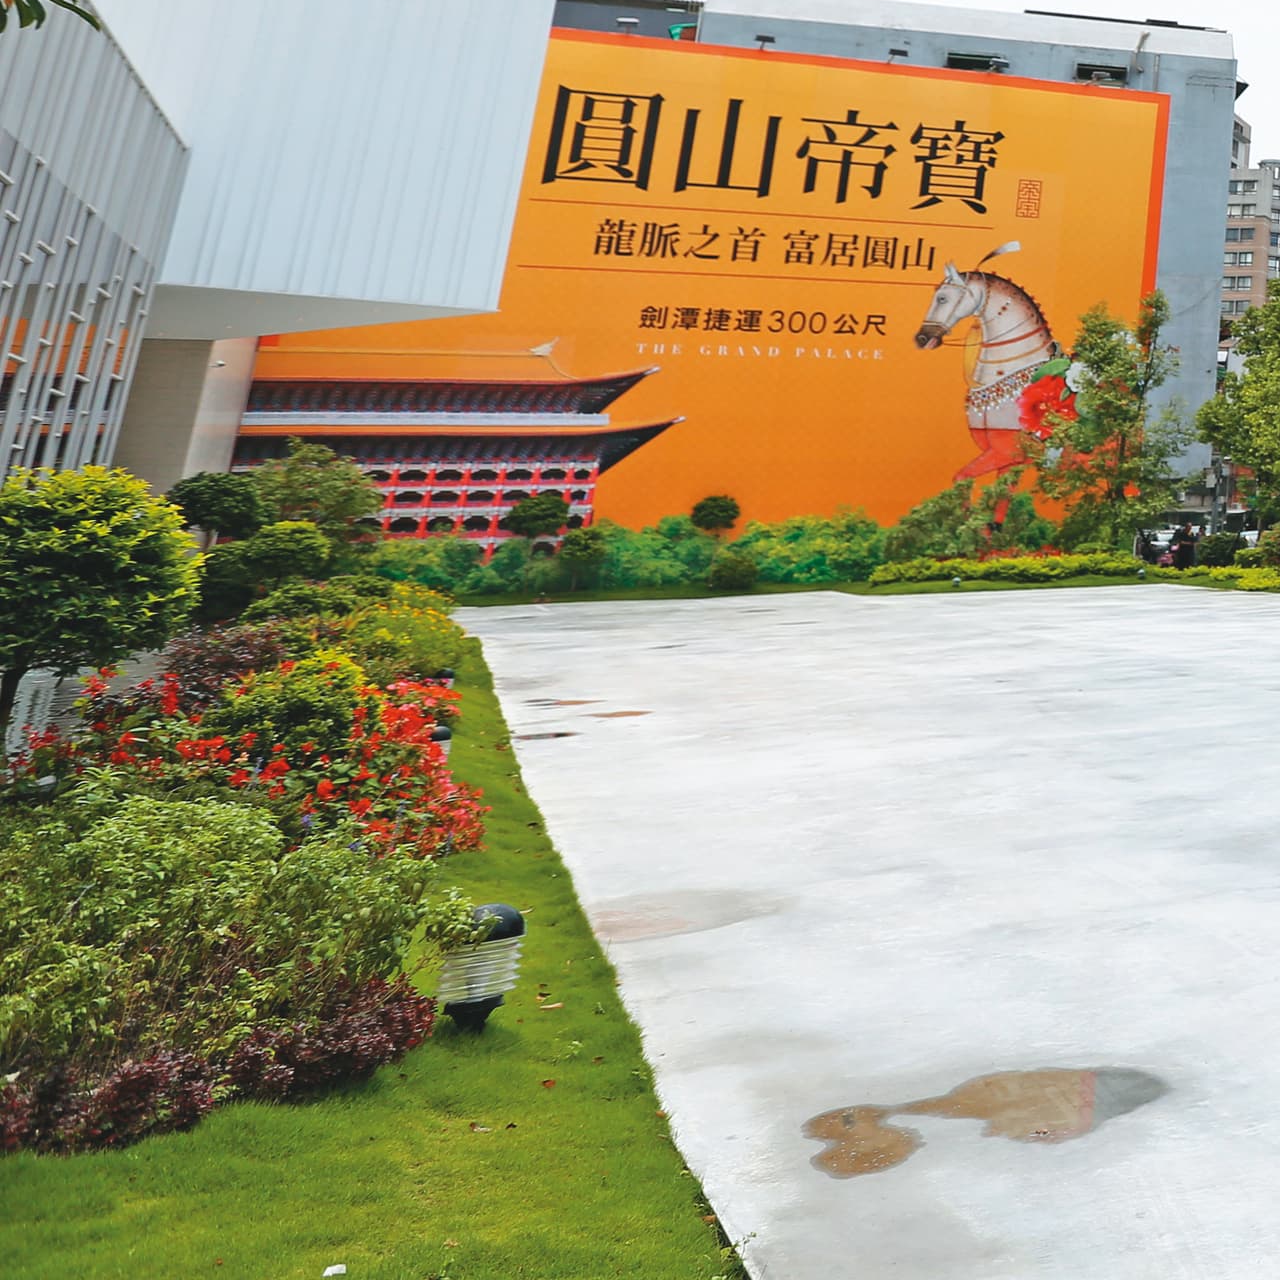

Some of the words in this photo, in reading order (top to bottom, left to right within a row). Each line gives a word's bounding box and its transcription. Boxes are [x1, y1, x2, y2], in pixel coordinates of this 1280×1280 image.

[542, 85, 1005, 215] 圓山帝寶
[594, 218, 765, 262] 龍脈之首
[783, 230, 935, 271] 富居圓山
[636, 343, 683, 355] THE
[700, 345, 781, 358] GRAND
[796, 346, 885, 360] PALACE
